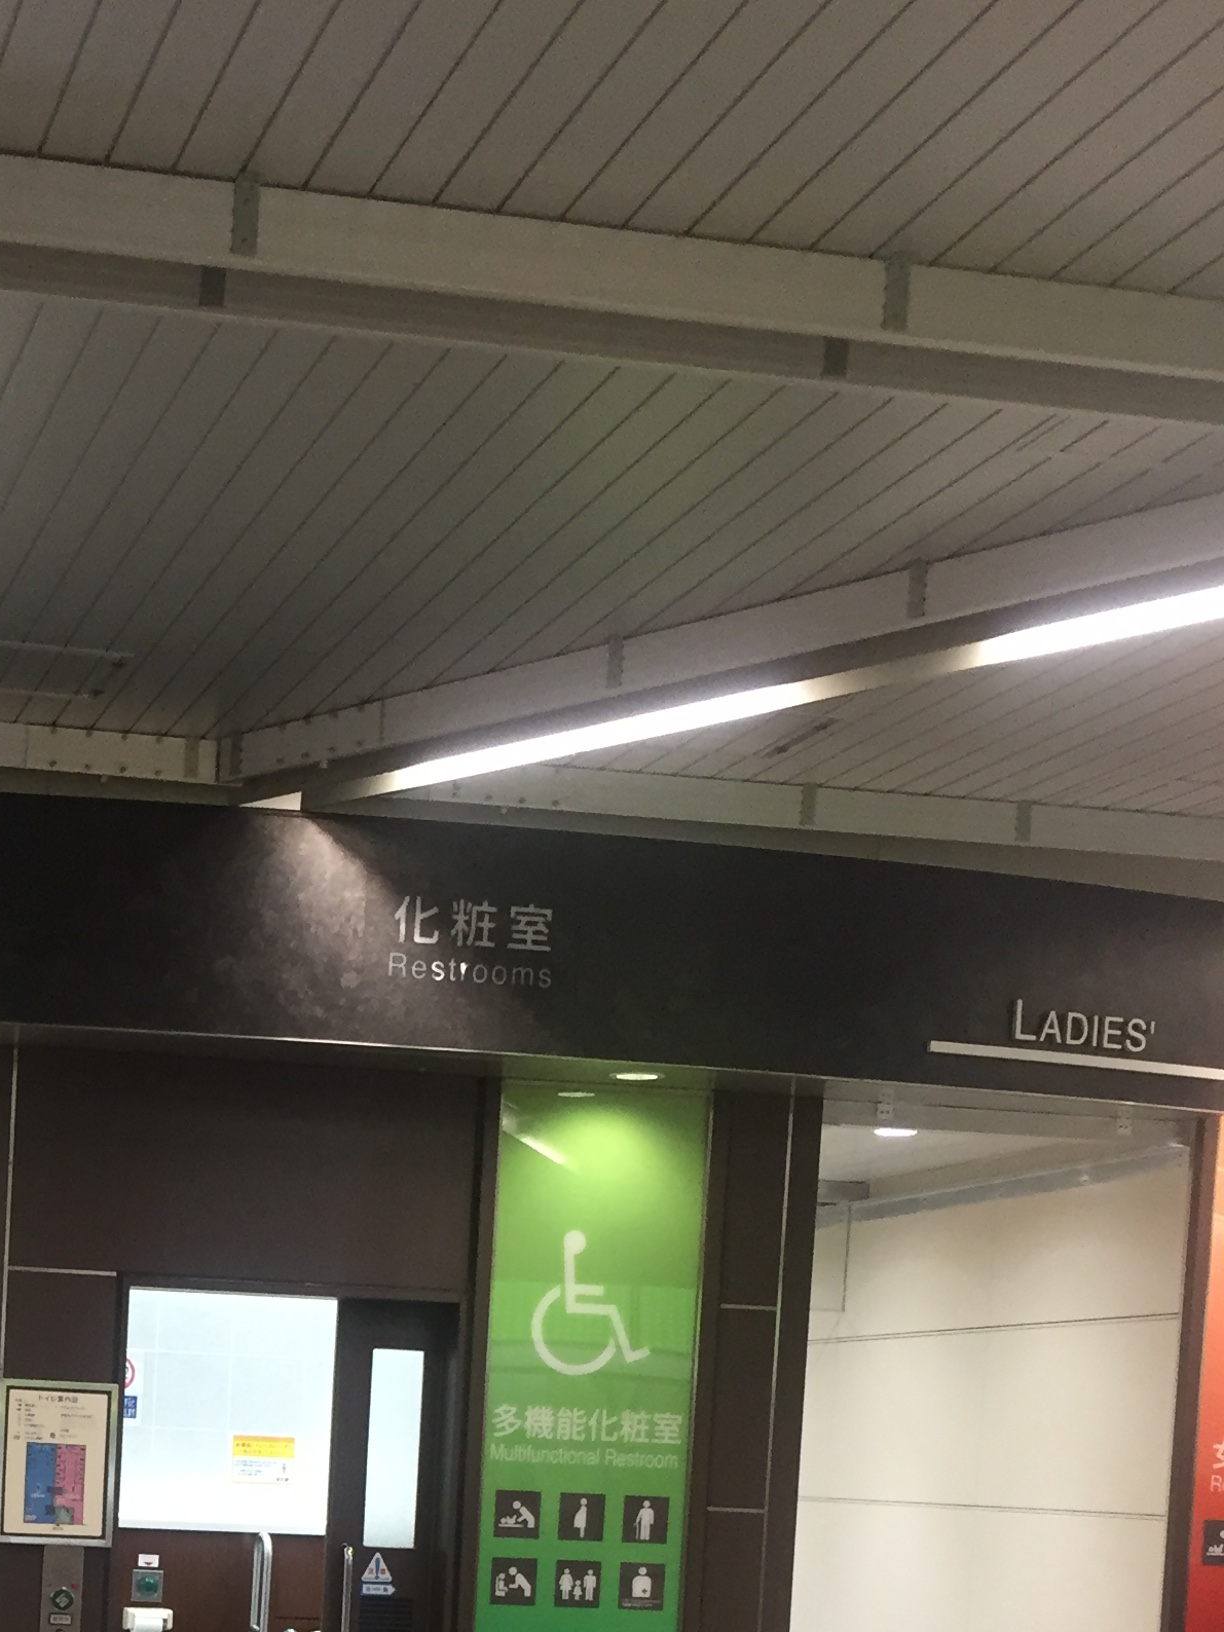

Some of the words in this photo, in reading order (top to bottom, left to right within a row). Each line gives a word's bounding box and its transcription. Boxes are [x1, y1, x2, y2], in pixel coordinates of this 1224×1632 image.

[394, 895, 553, 952] 化粧室
[387, 952, 552, 988] Restrooms
[492, 1403, 682, 1444] 多機能化粧室
[489, 1443, 600, 1466] Multifunctional
